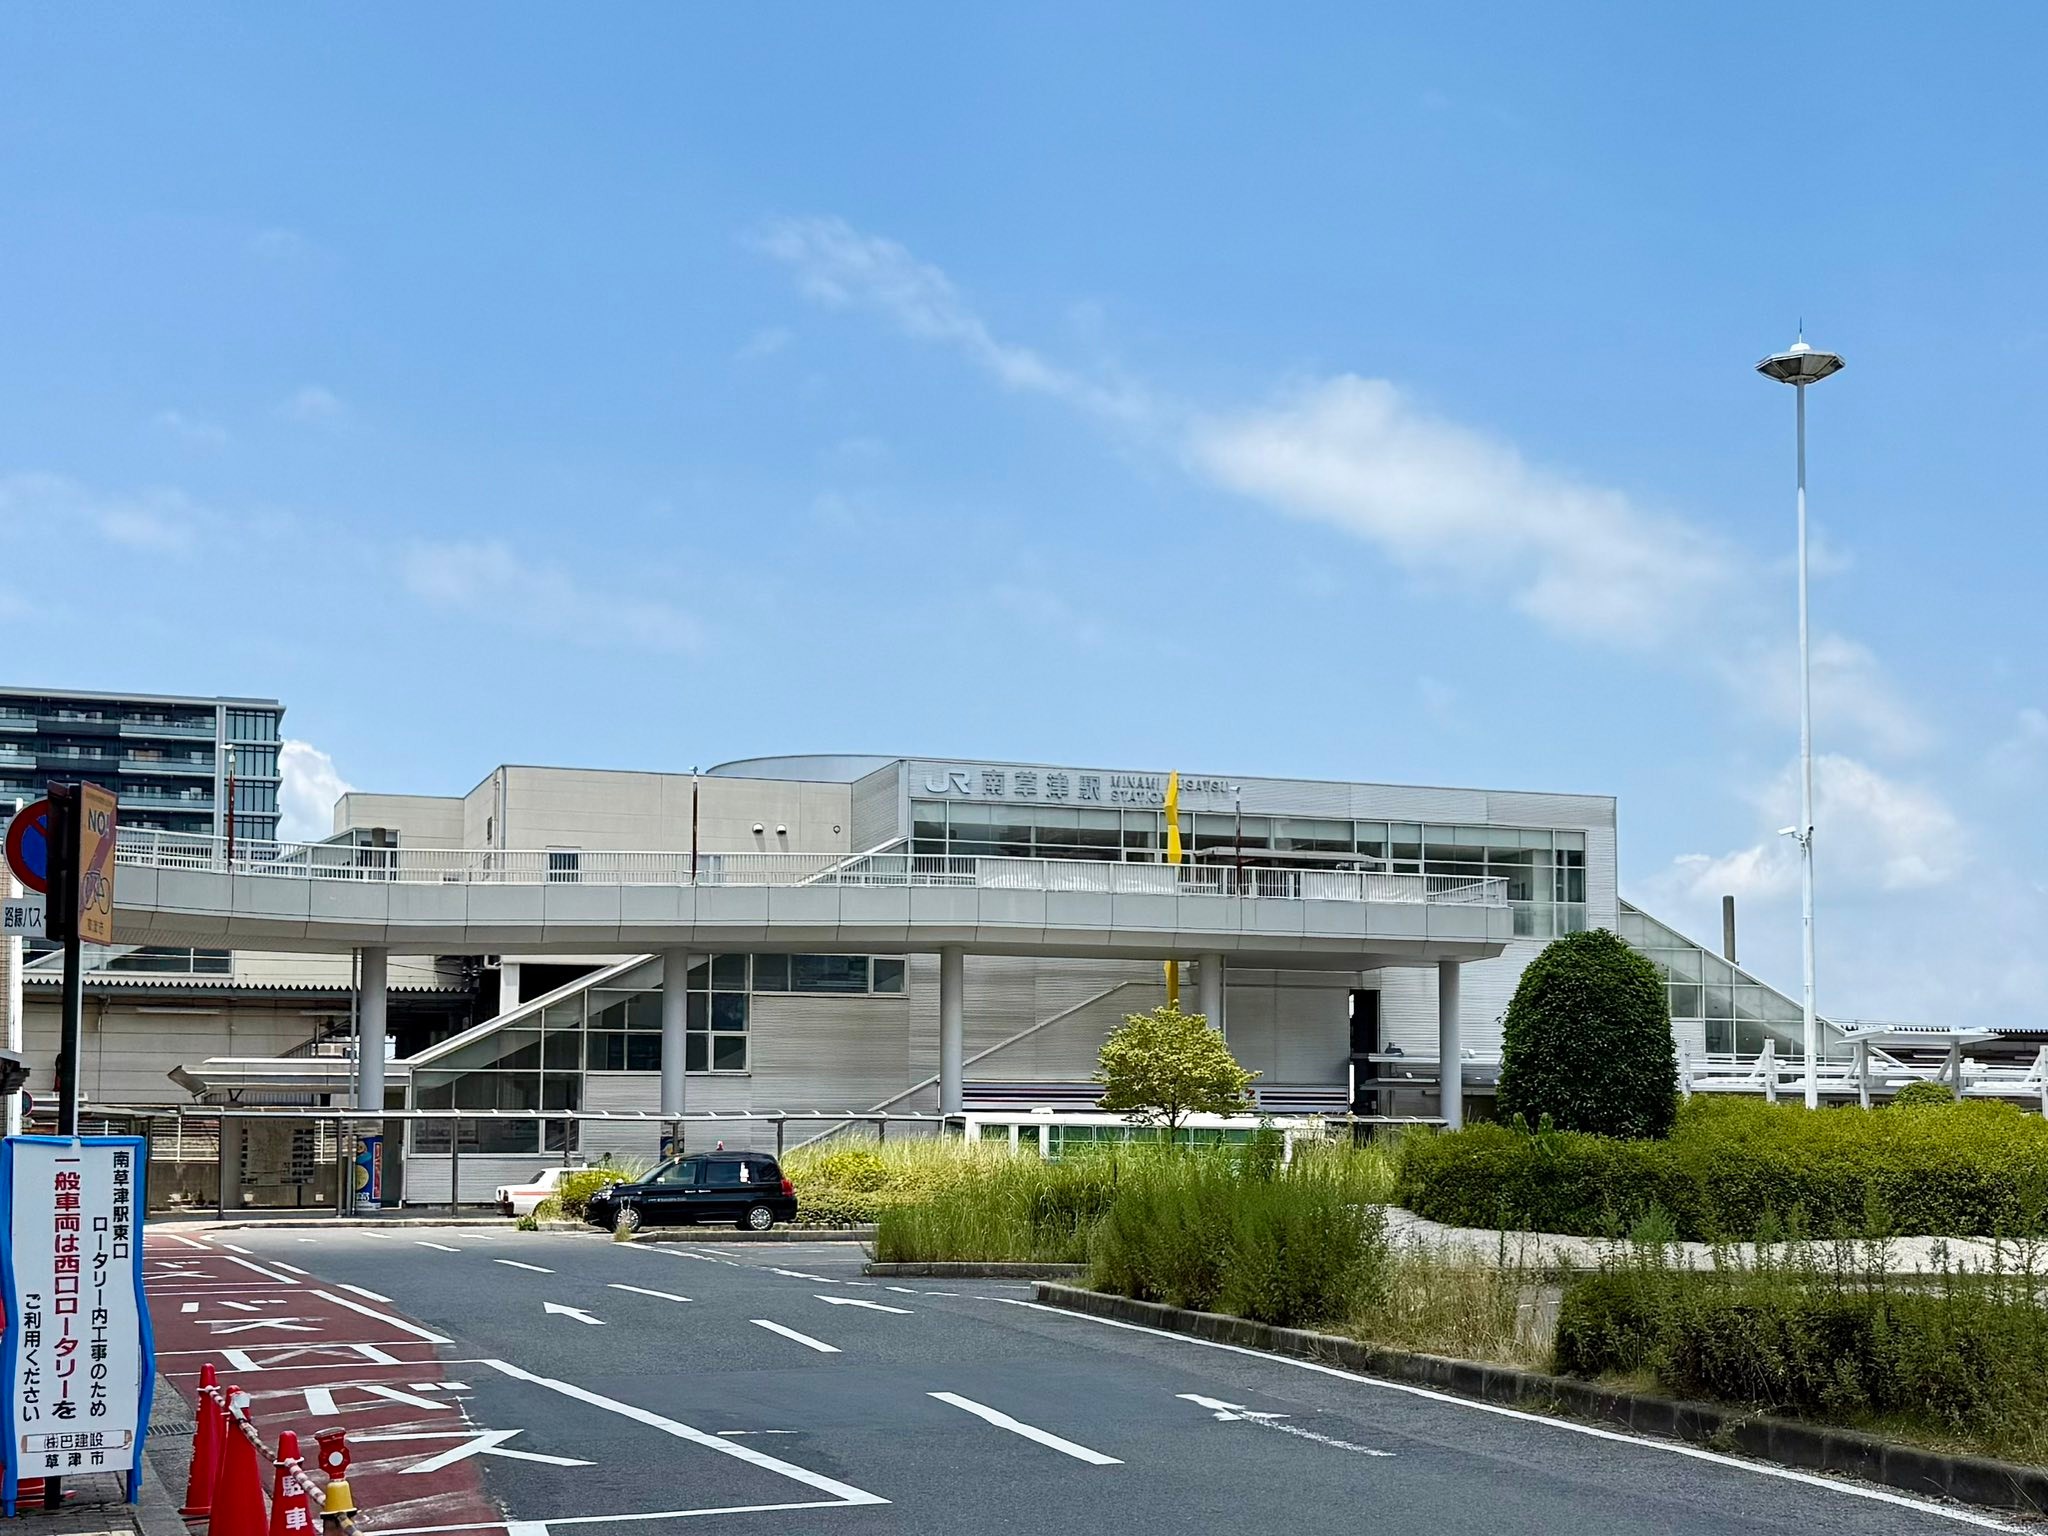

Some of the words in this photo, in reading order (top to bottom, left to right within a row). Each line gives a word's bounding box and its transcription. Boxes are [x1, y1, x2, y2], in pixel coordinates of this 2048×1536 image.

[924, 770, 971, 794] JR
[981, 769, 1100, 801] 南草津駅
[1110, 775, 1160, 791] MINAMI
[1167, 778, 1229, 793] USATSU
[87, 807, 110, 838] NO!
[4, 906, 47, 928] 路線バス
[112, 1150, 130, 1259] 南草津駅東口
[52, 1157, 81, 1420] 一般車両は西口ロータリーを
[90, 1216, 108, 1418] ロータリー内工事のため
[22, 1293, 42, 1422] ご利用ください
[45, 1451, 104, 1469] 草津市
